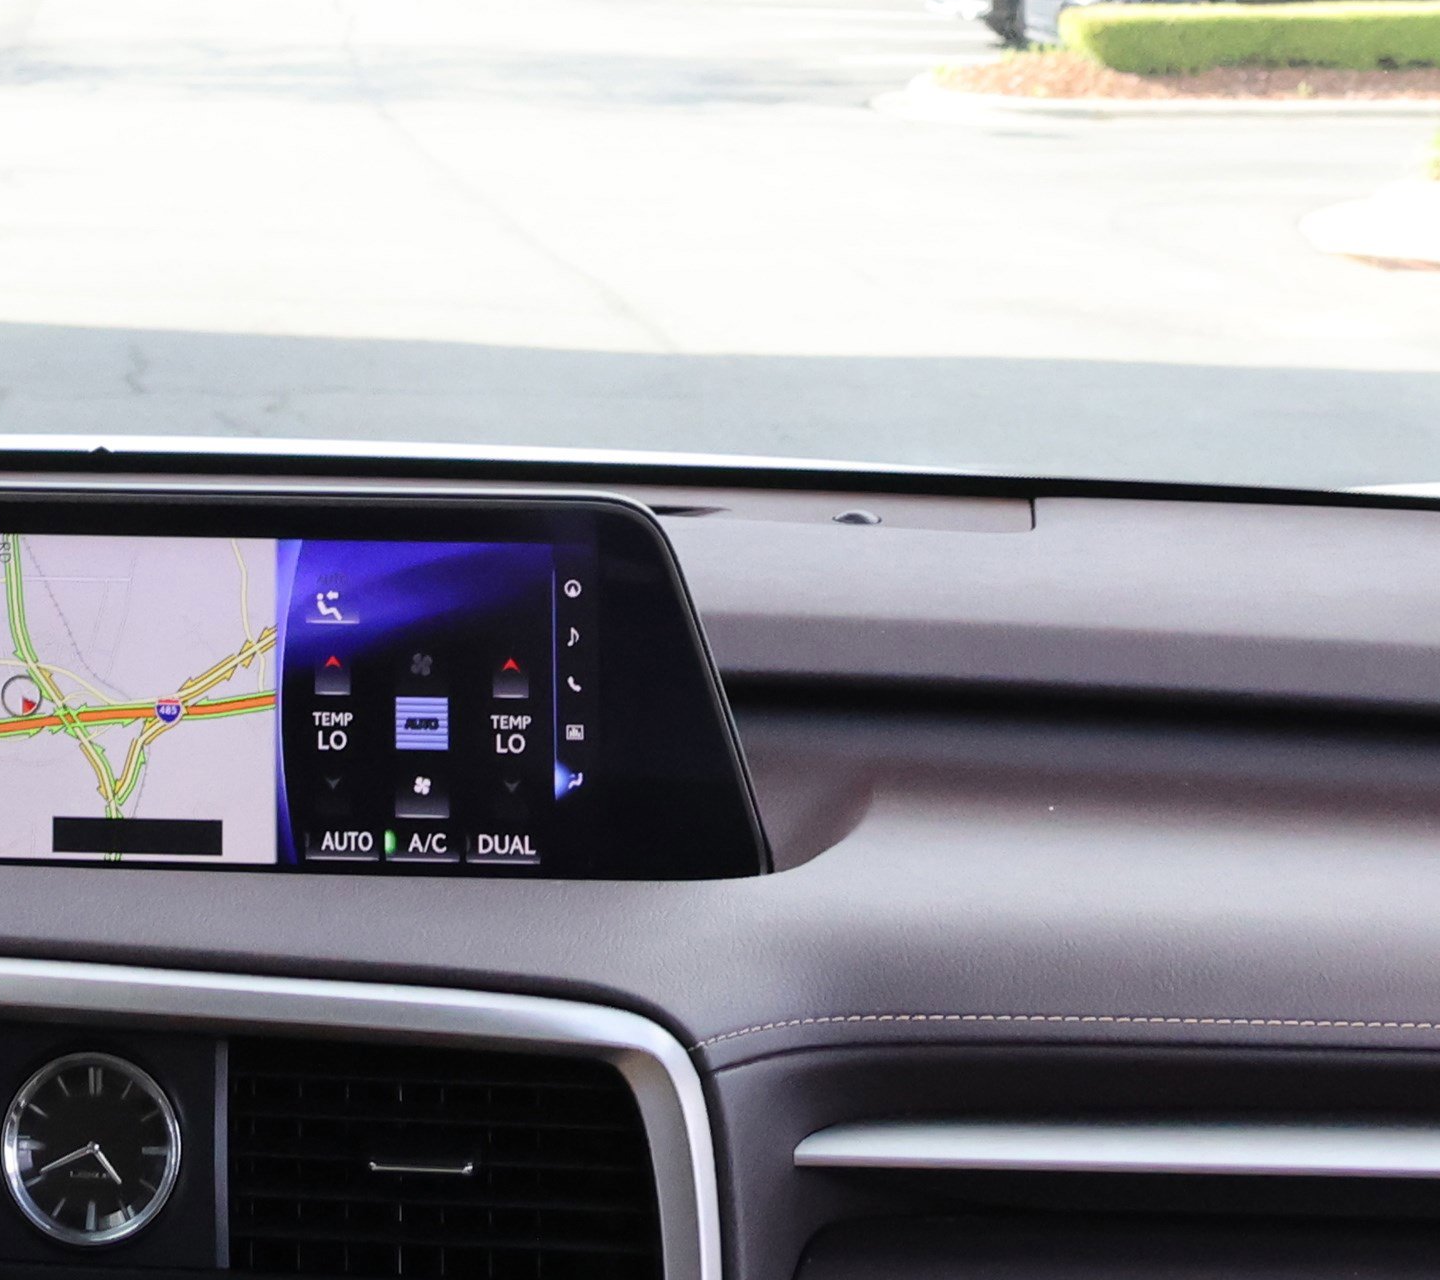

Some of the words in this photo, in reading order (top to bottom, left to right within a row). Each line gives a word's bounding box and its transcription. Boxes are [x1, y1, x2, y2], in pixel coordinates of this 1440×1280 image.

[159, 705, 177, 715] 485
[312, 712, 353, 727] TEMP
[490, 715, 531, 730] TEMP
[318, 731, 347, 750] LO
[496, 734, 525, 753] LO
[321, 831, 373, 852] AUTO
[408, 833, 447, 854] A/C
[478, 834, 536, 855] DUAL
